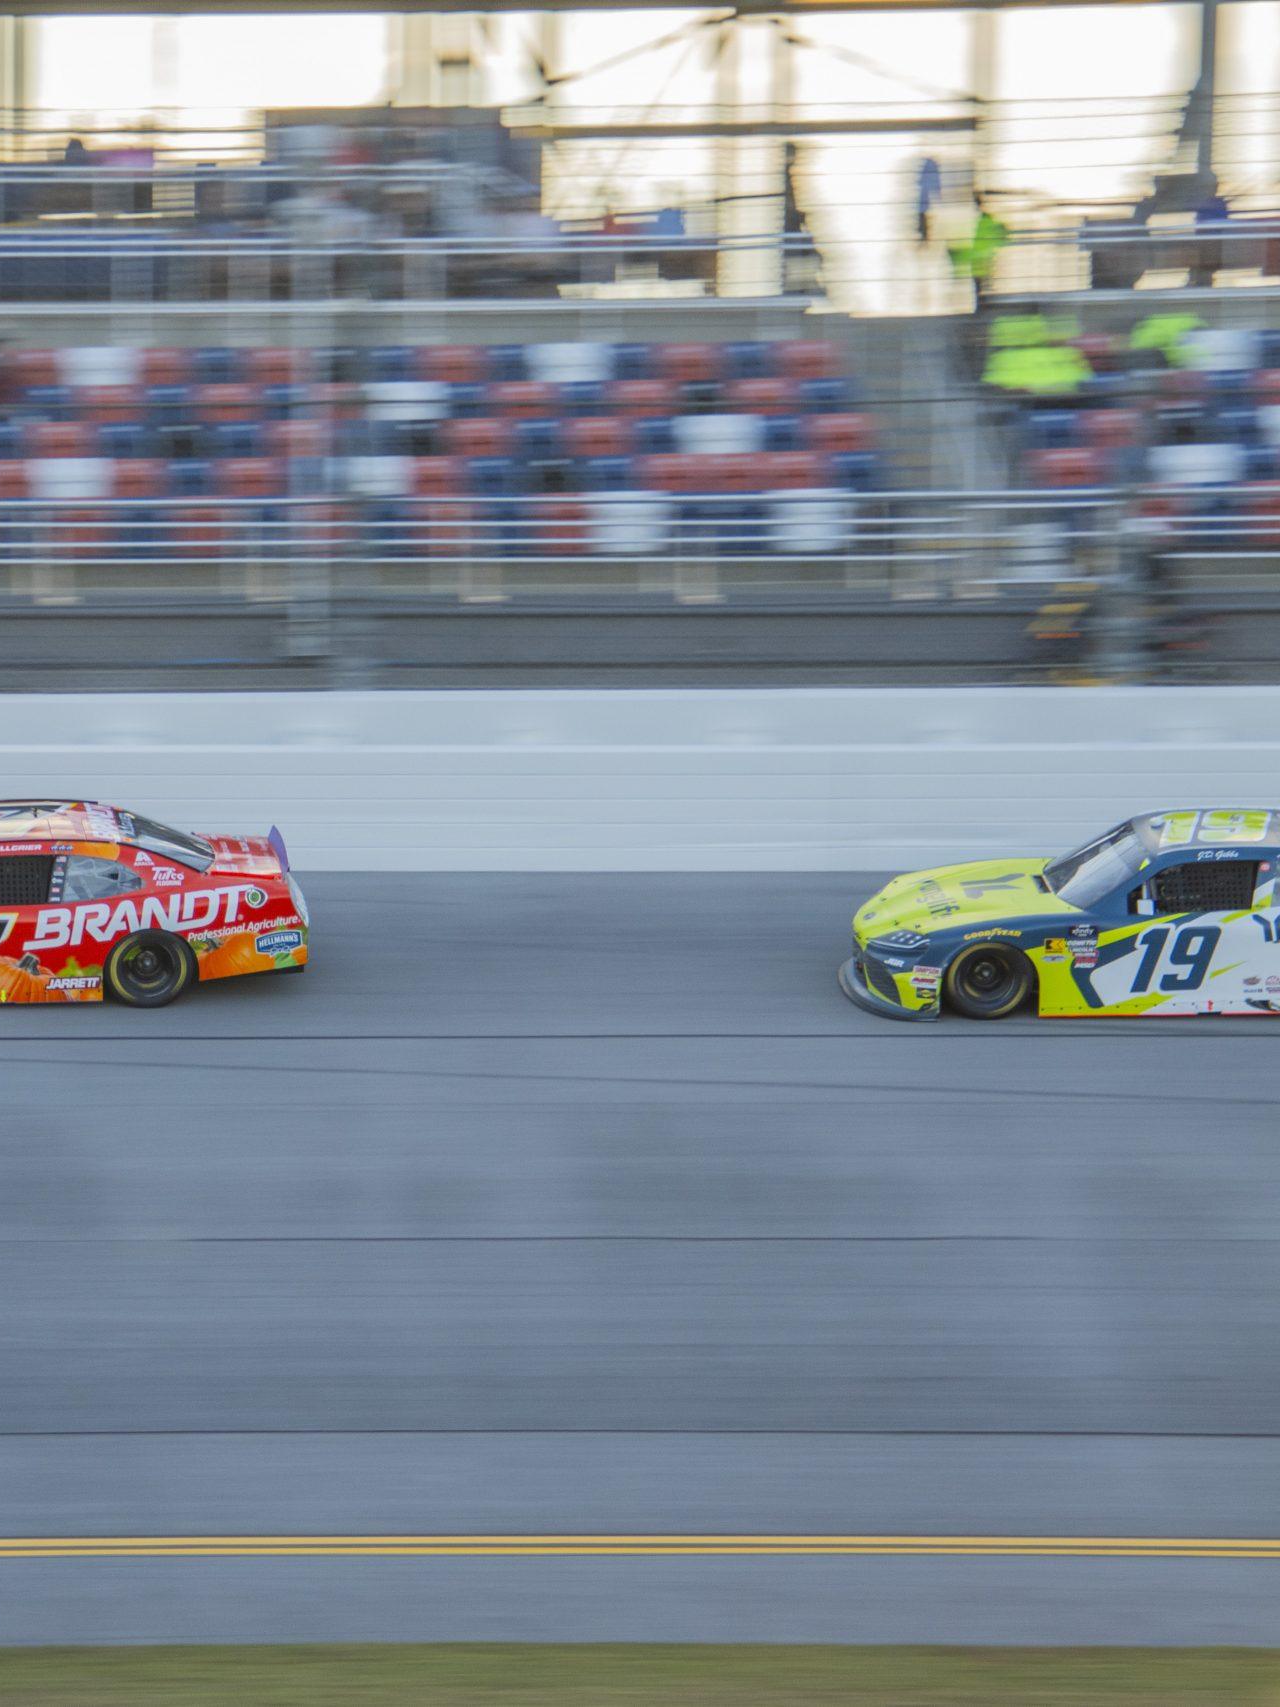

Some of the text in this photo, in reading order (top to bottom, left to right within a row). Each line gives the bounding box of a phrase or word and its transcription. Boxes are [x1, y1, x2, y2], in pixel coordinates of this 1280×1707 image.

[1148, 809, 1272, 848] 19
[151, 866, 185, 881] Tufco
[23, 884, 254, 951] BRANDT
[187, 923, 246, 942] Professional
[258, 933, 299, 947] HELLMANN'S
[963, 928, 1023, 941] GOODYEAR
[1129, 923, 1224, 996] 19
[46, 977, 100, 990] JARRETT
